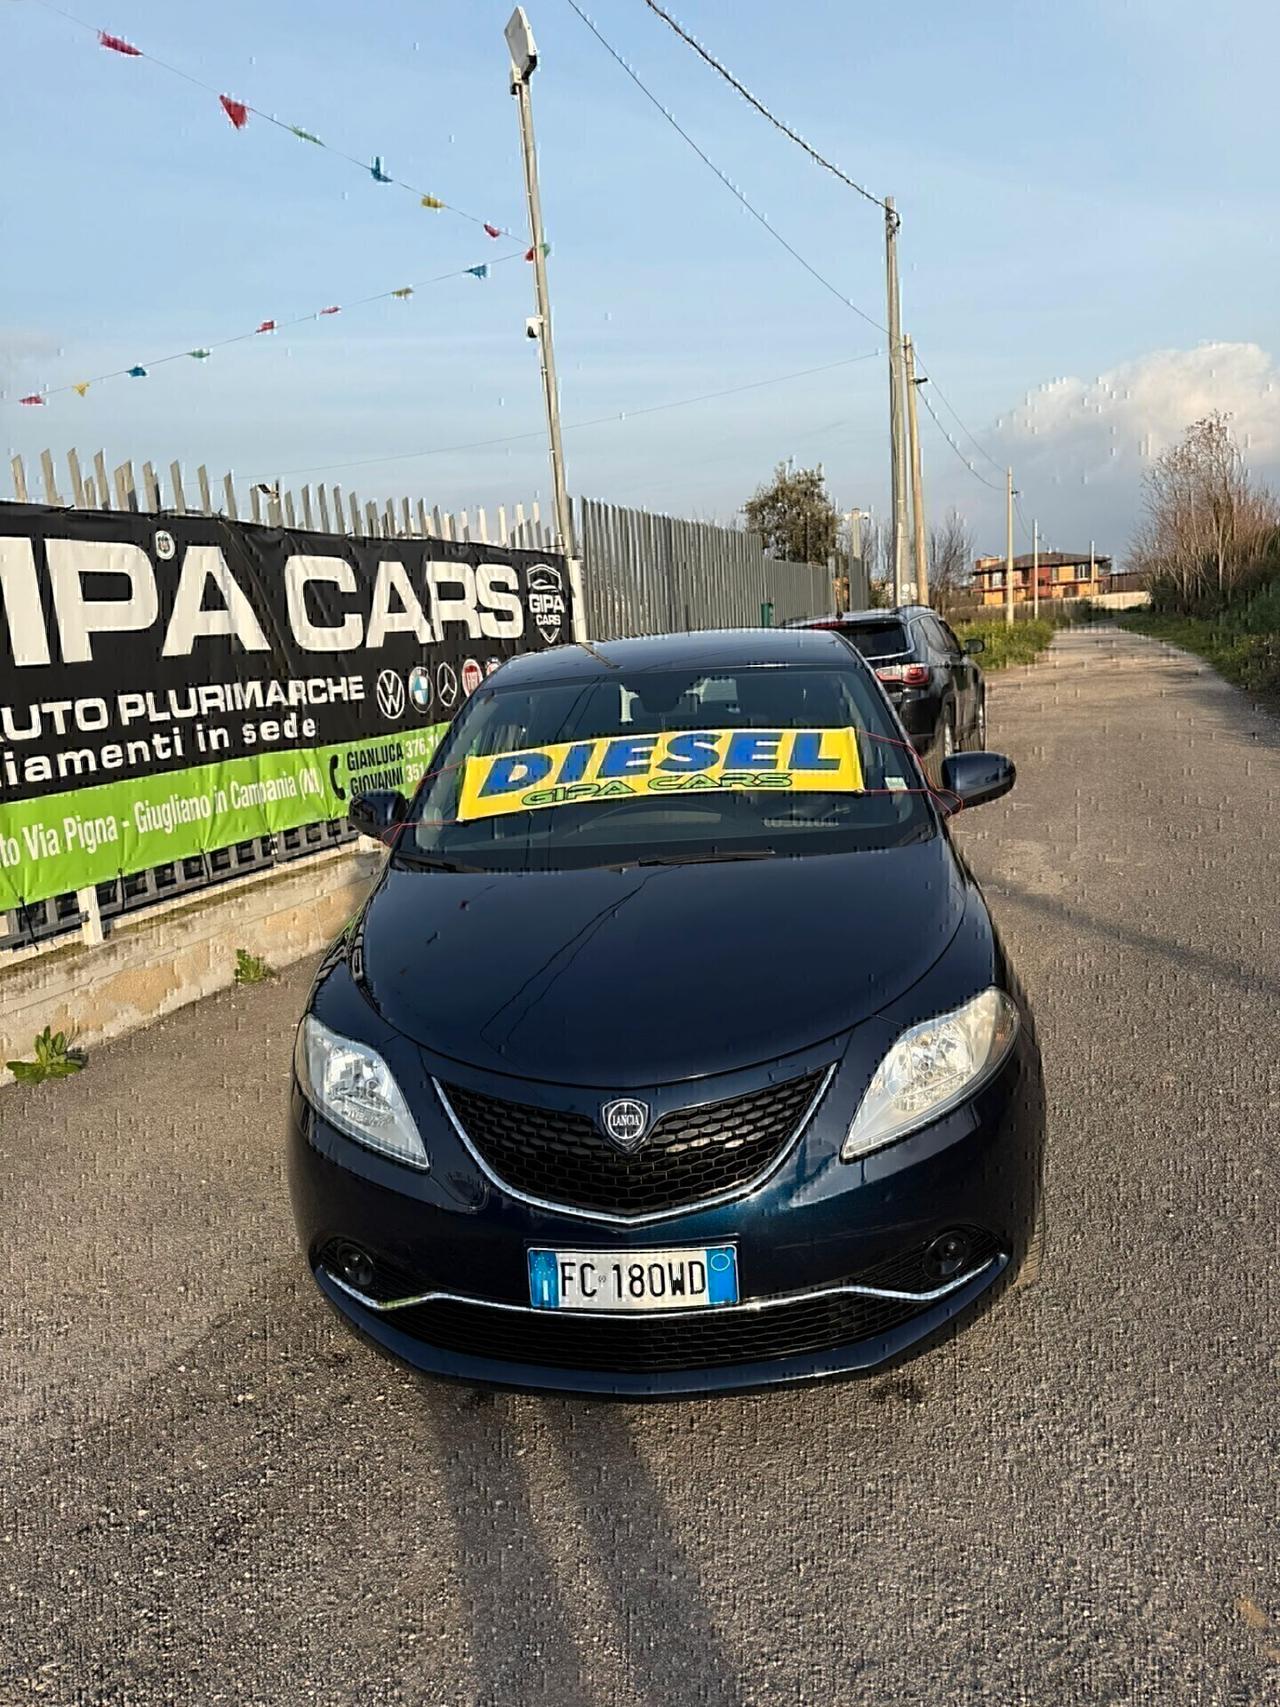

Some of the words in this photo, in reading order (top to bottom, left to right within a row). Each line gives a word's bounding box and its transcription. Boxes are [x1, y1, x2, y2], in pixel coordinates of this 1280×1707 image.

[284, 555, 524, 652] CARS
[528, 593, 566, 613] GIPA
[535, 614, 561, 627] CARS
[0, 697, 109, 742] UTO
[117, 675, 366, 727] PLURIMARCHE
[0, 726, 185, 788] iamenti
[196, 723, 230, 753] in
[241, 712, 316, 745] sede
[346, 742, 404, 771] GIANLUCA
[477, 731, 842, 798] DIESEL
[350, 766, 404, 797] GIOVANNI
[521, 780, 637, 806] GIPA
[647, 772, 793, 791] CARS
[22, 822, 61, 861] Via
[63, 815, 119, 855] Pigna
[133, 794, 211, 834] Giugliano
[213, 783, 228, 815] in
[230, 770, 298, 811] Campania
[611, 1114, 641, 1127] LANCIA
[560, 1262, 597, 1298] FC
[612, 1260, 707, 1299] 180WD
